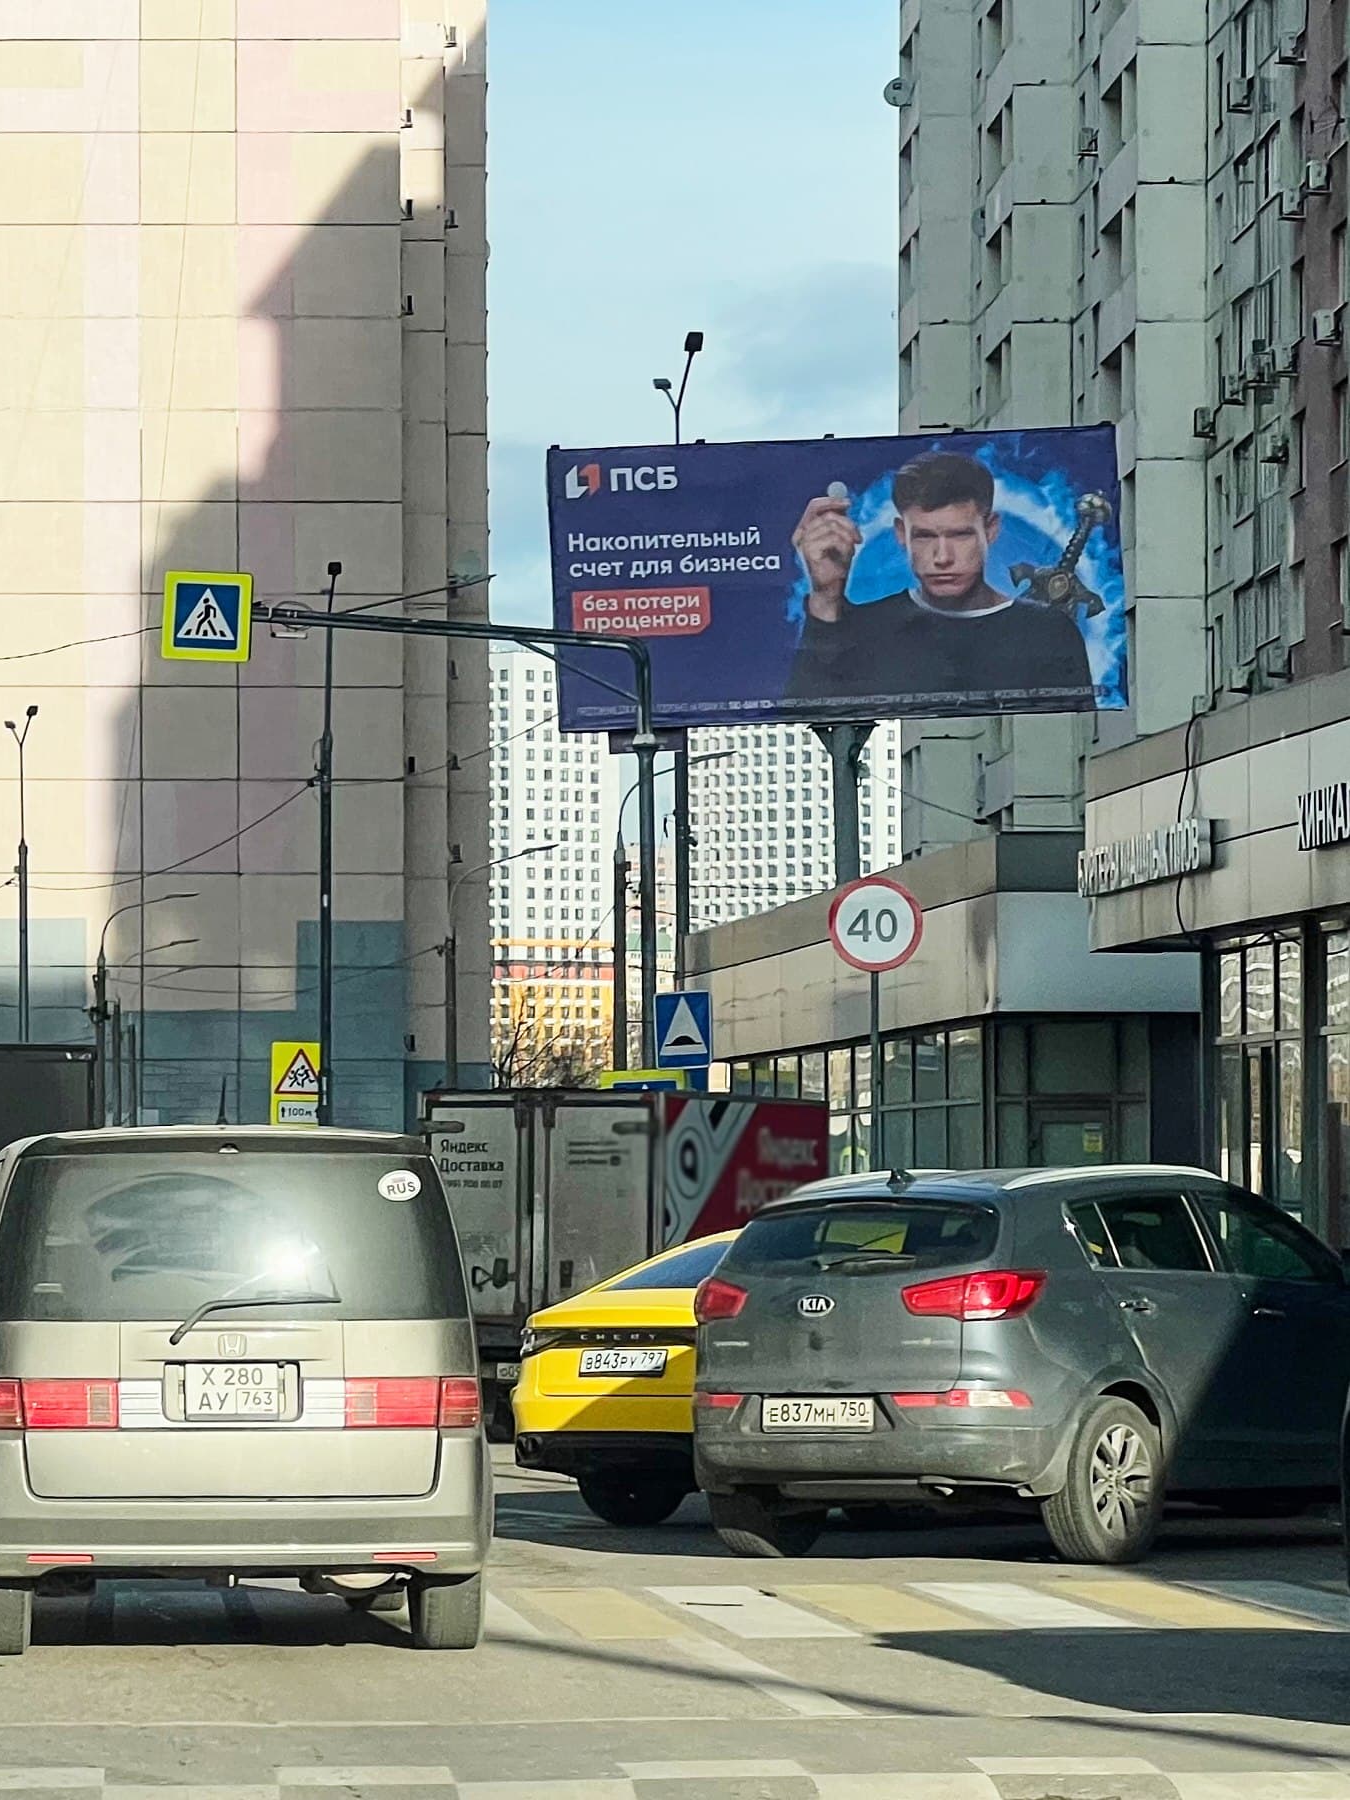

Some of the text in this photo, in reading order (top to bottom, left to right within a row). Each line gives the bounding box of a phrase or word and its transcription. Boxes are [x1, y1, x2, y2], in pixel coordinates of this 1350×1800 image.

[609, 466, 678, 492] ПСБ
[567, 526, 761, 553] Накопительный
[569, 554, 781, 579] счет для бизнеса
[582, 593, 701, 614] без потери
[583, 612, 701, 633] процентов
[846, 908, 898, 943] 40
[440, 1139, 489, 1154] Яндекс
[440, 1158, 505, 1174] Доставка
[386, 1181, 417, 1197] RUS
[802, 1297, 827, 1311] KIA
[224, 1367, 263, 1386] 280
[241, 1391, 273, 1406] 763
